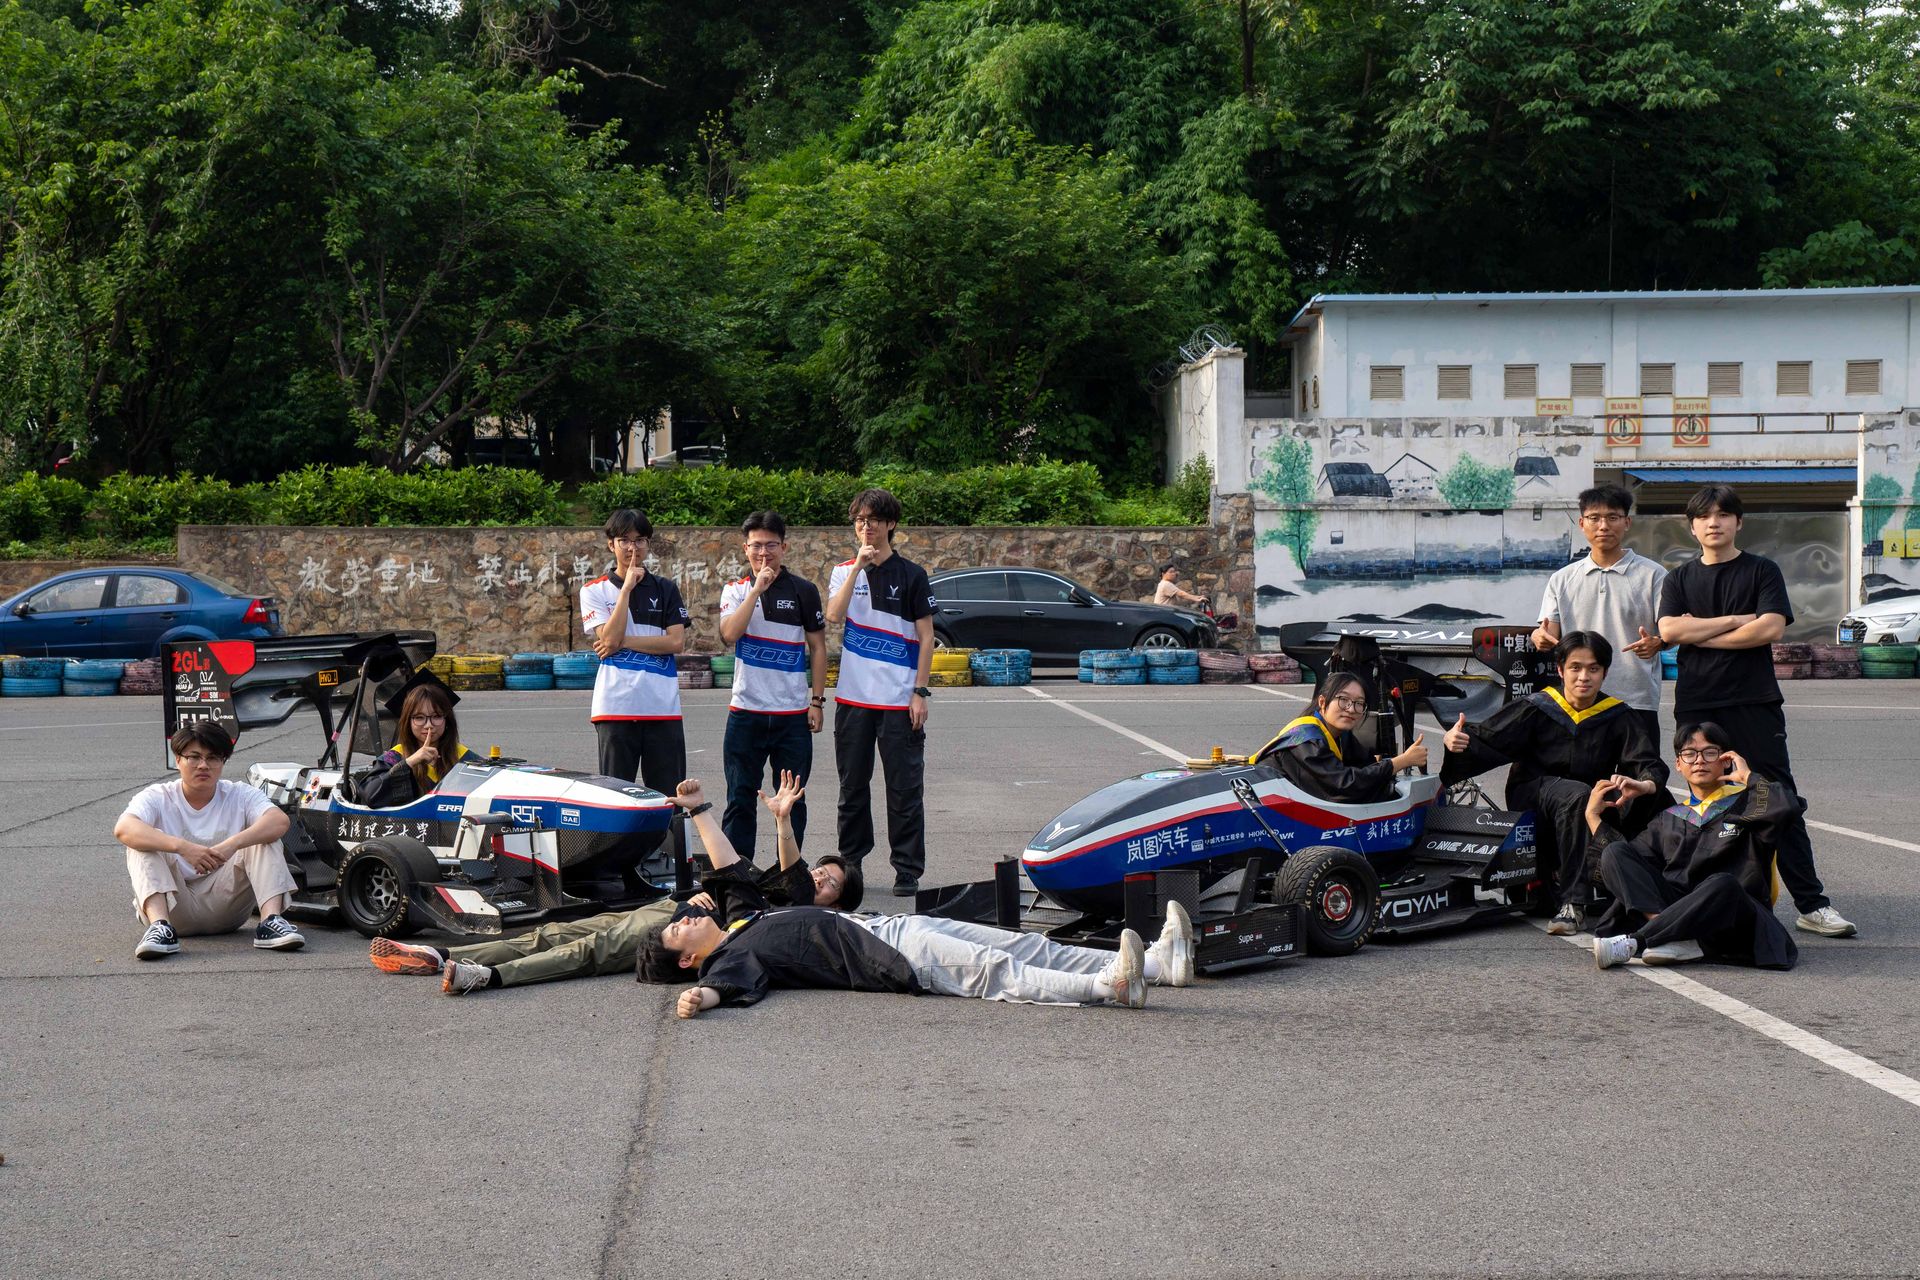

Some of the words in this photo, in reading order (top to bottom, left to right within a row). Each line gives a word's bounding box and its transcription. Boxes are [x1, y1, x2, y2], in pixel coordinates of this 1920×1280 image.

[1512, 683, 1533, 694] SMT
[1127, 827, 1190, 864] 岚图汽车
